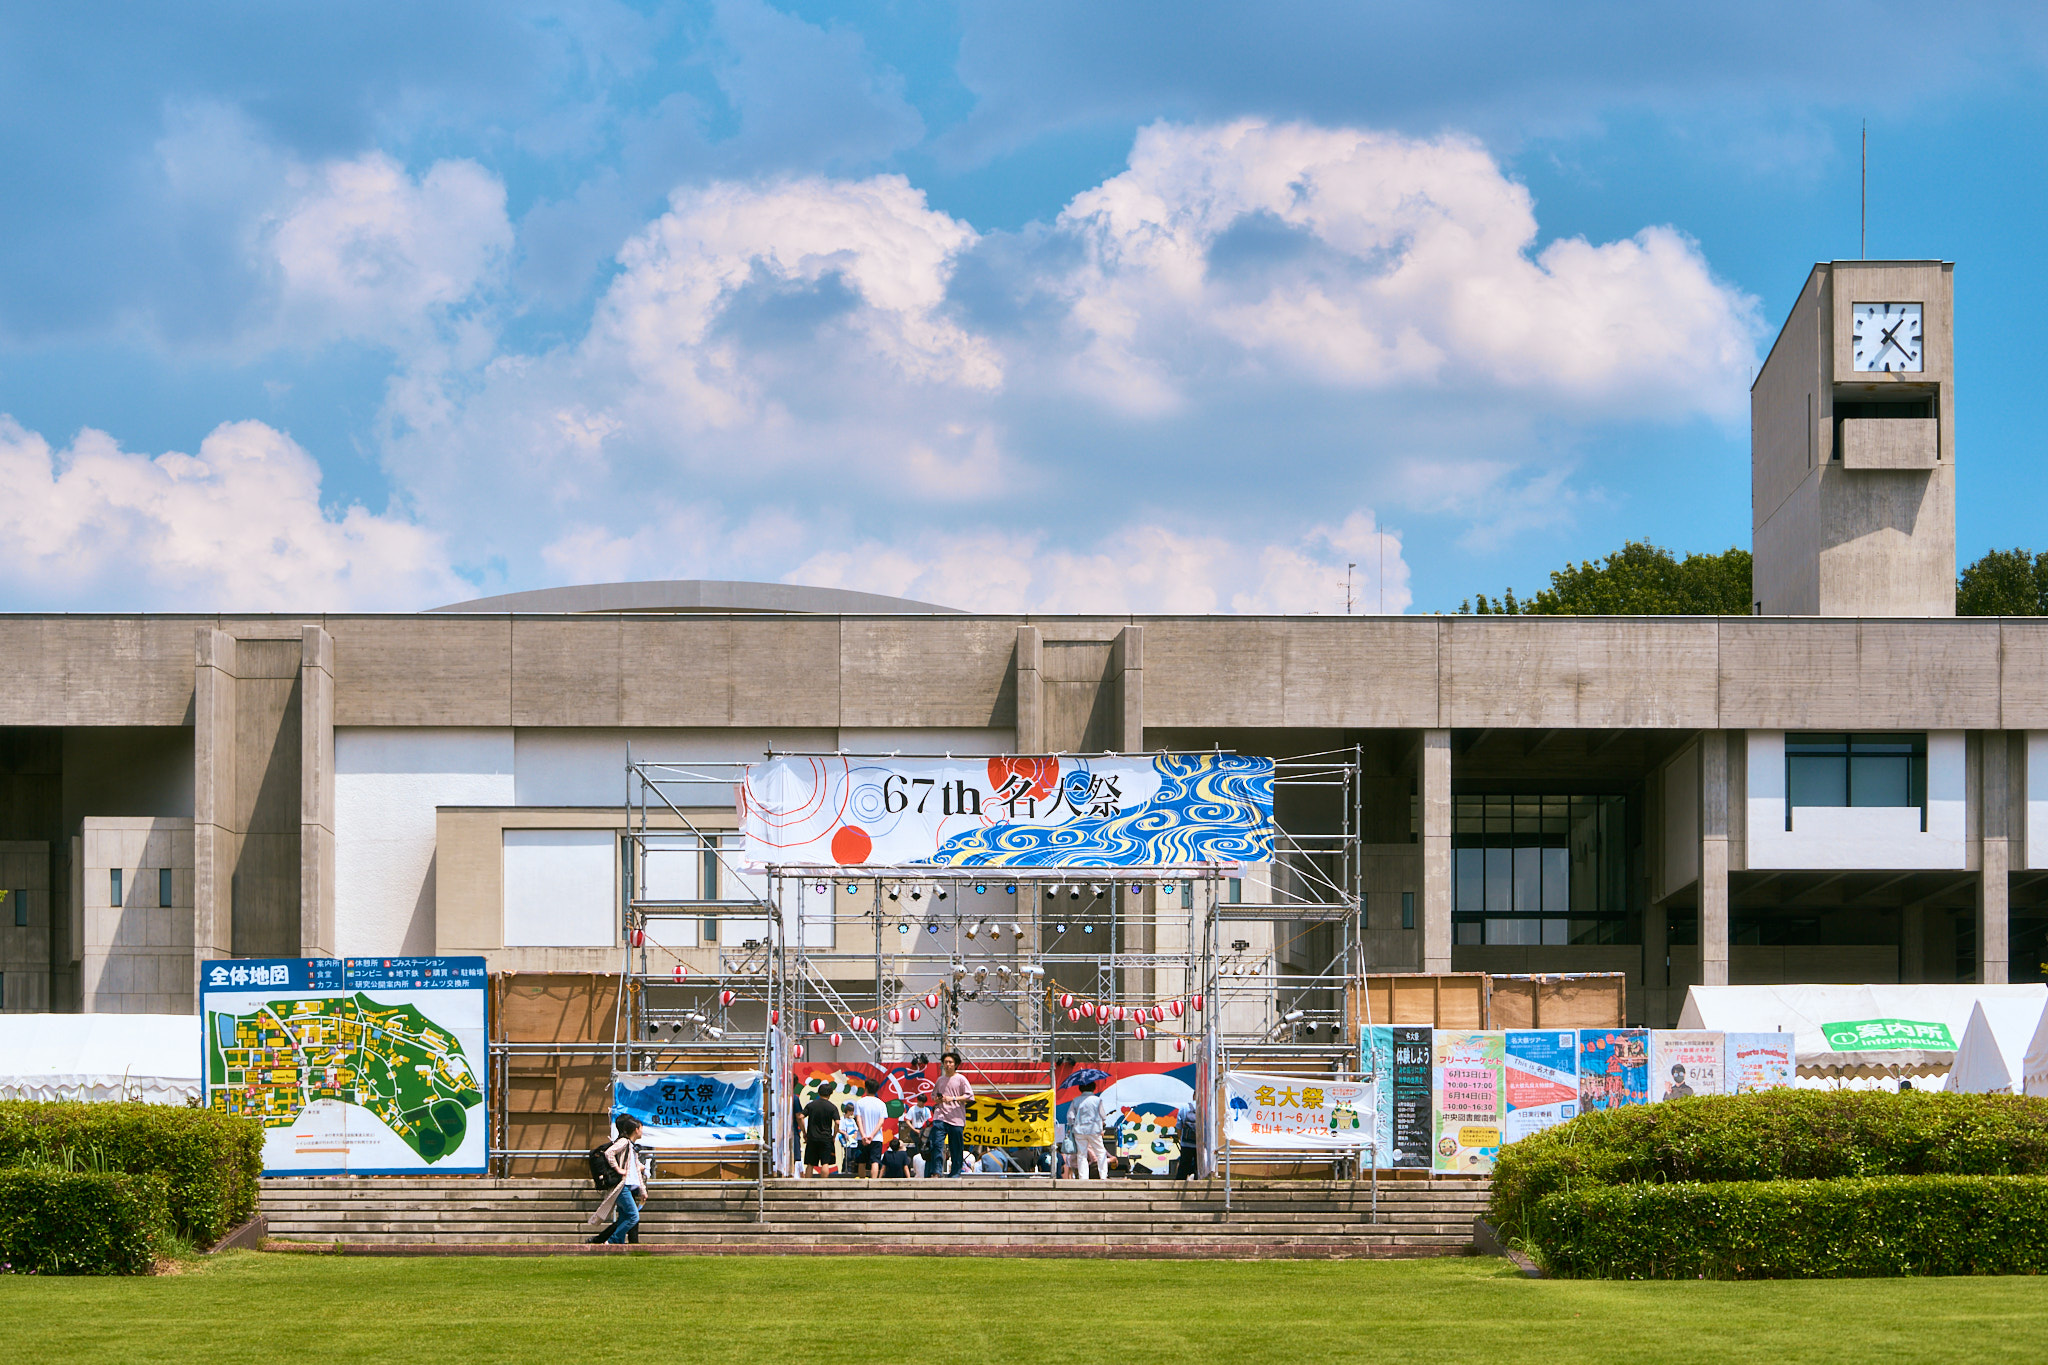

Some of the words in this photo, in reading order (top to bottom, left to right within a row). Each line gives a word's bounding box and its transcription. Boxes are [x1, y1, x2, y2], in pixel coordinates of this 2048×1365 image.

[883, 774, 983, 816] 67th
[997, 773, 1122, 819] 名大祭
[316, 960, 340, 968] 案内所
[391, 959, 445, 967] ごみステーション
[209, 965, 290, 987] 全体地図
[317, 970, 333, 979] 食堂
[396, 969, 419, 977] 地下鉄
[432, 969, 448, 977] 購買
[461, 968, 484, 977] 駐輪場
[355, 980, 409, 989] 研究公開案内所
[423, 980, 470, 988] オムツ交換所
[1856, 1023, 1944, 1040] 案内所
[1397, 1046, 1430, 1065] 体験しよう
[1676, 1054, 1717, 1064] 「伝える力」
[1736, 1049, 1760, 1059] Sports
[1439, 1056, 1503, 1065] フリーマーケット
[1514, 1058, 1528, 1068] This
[1529, 1062, 1535, 1070] is
[1537, 1065, 1556, 1077] 名大祭
[1448, 1071, 1492, 1079] 6月13日(土)
[1690, 1067, 1715, 1081] 6/14
[661, 1084, 714, 1102] 名大祭
[1254, 1085, 1325, 1110] 名大祭
[1448, 1092, 1492, 1100] 6月14日(日)
[656, 1105, 718, 1116] 6/11～6/14
[652, 1114, 727, 1126] 東山キャンパス
[1256, 1110, 1326, 1124] 6/11～6/14
[1442, 1113, 1497, 1122] 中央図書館南側
[1250, 1122, 1330, 1136] 東山キャンパス
